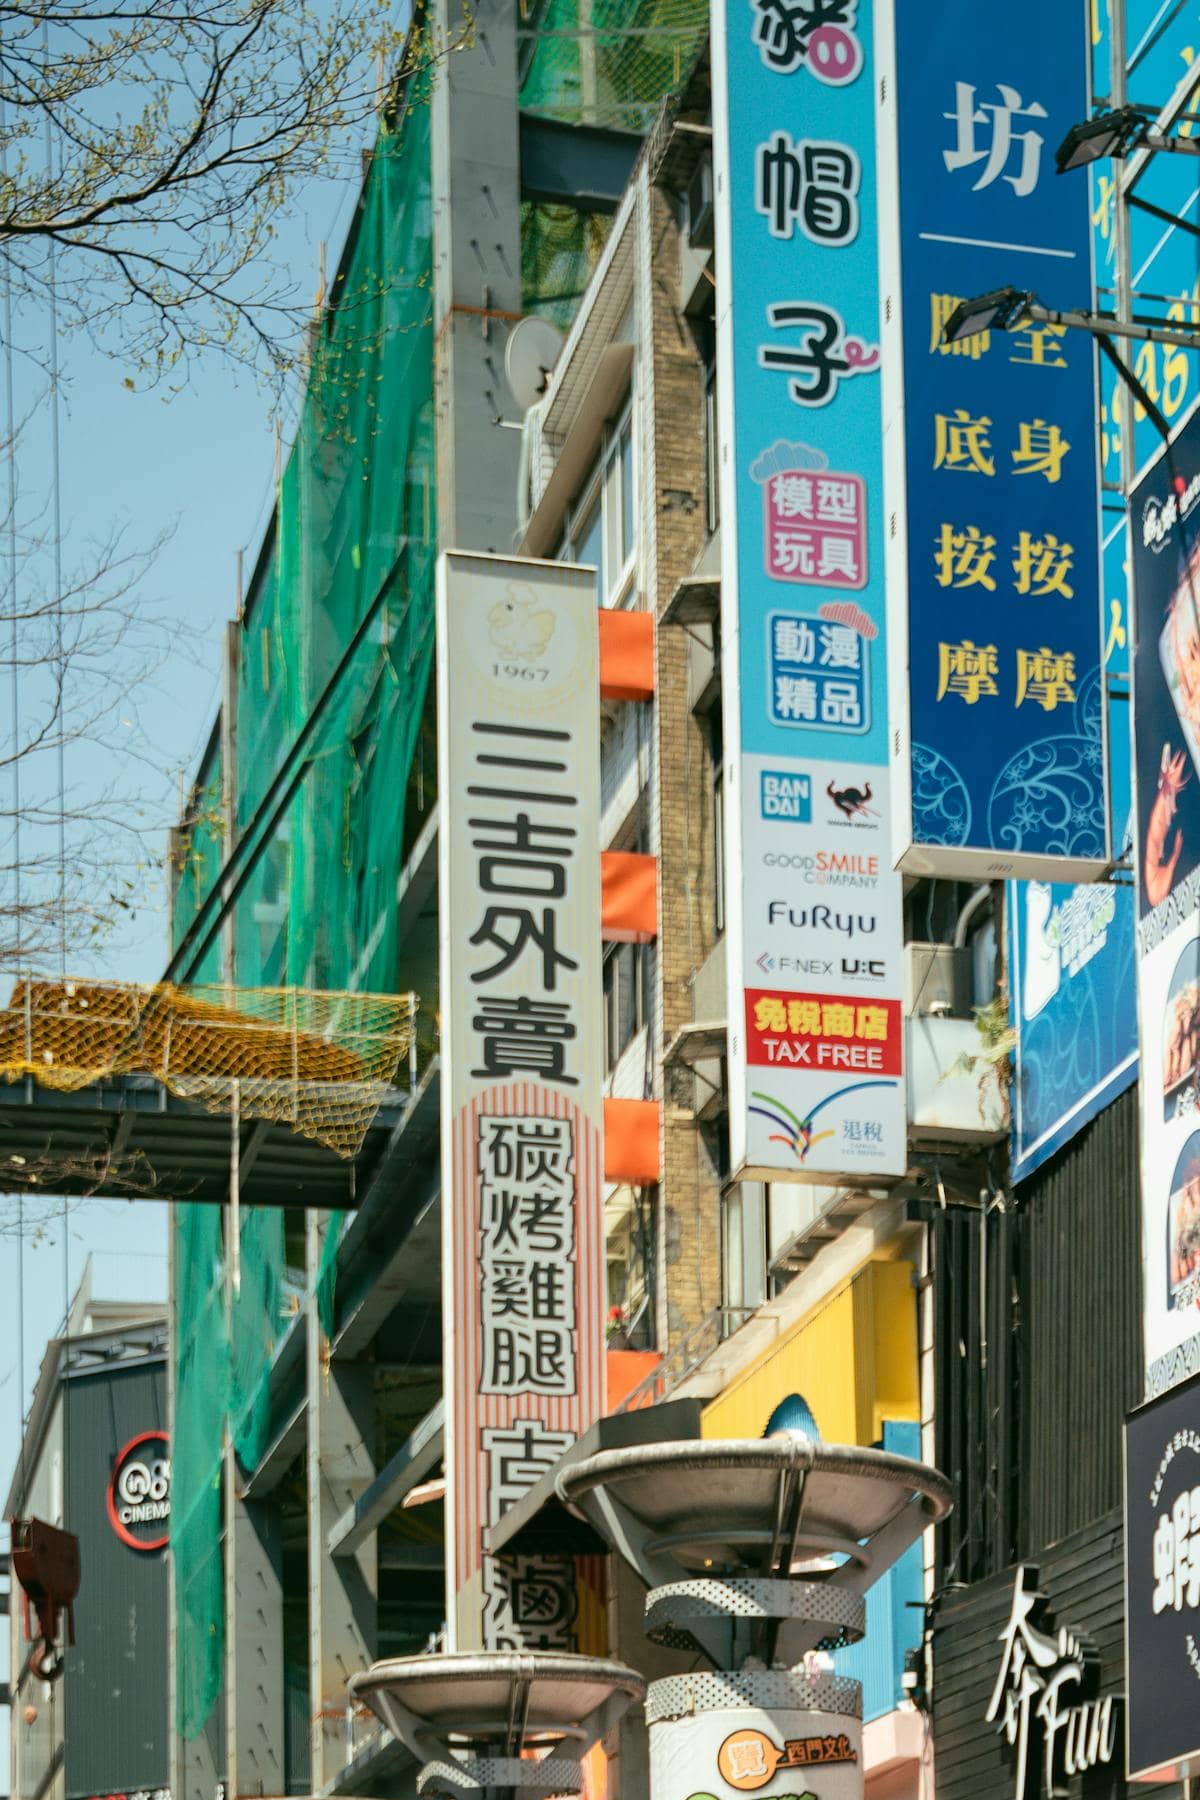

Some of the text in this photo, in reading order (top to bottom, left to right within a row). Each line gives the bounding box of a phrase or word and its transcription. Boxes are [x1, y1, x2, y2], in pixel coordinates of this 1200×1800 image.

[943, 81, 1048, 196] 坊
[772, 475, 858, 525] 模型
[1008, 312, 1077, 711] 全身按摩
[774, 530, 858, 580] 玩具
[774, 618, 862, 670] 動漫
[491, 663, 550, 682] 1967
[775, 676, 862, 725] 精品
[763, 851, 879, 876] GOOD SMILE
[803, 872, 878, 889] COMPANY
[467, 722, 580, 1086] 三吉外賣
[768, 901, 876, 939] FuRyu
[754, 997, 890, 1041] 免稅商店
[761, 1039, 885, 1070] TAX FREE
[488, 1122, 567, 1388] 碳烤雞腿
